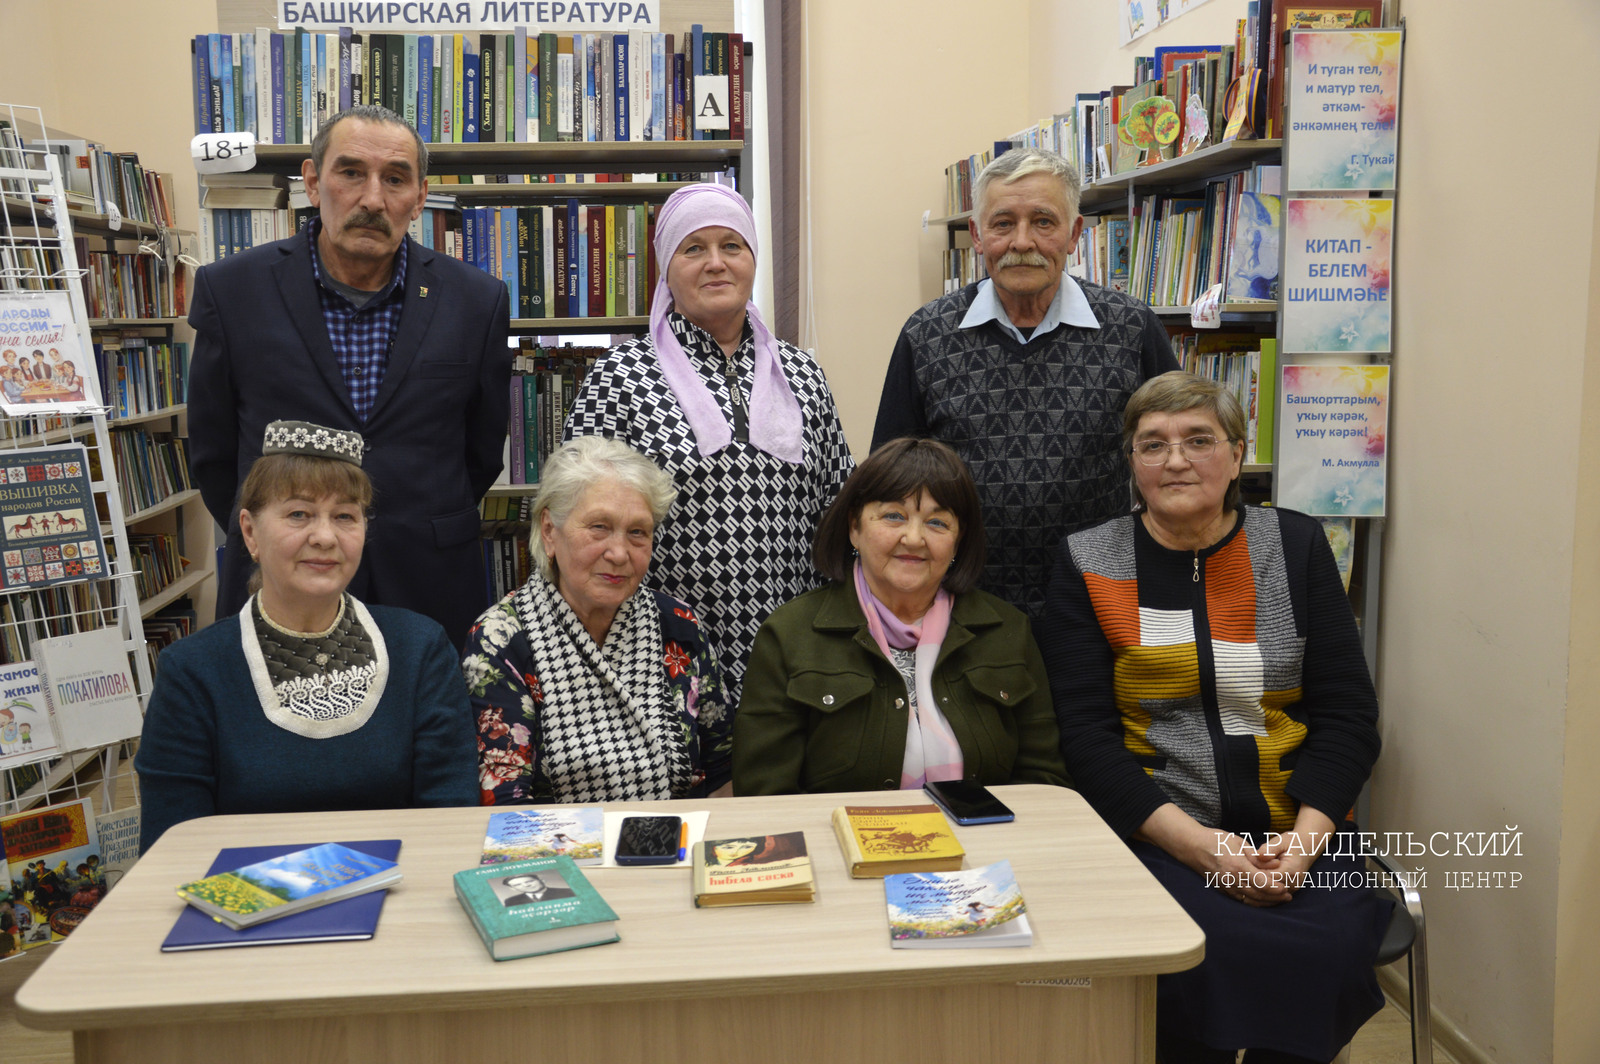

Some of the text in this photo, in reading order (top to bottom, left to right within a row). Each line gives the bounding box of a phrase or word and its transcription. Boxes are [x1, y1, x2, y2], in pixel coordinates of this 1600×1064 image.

[284, 1, 652, 25] БАШКИРСКАЯ ЛИТЕРАТУРА
[1308, 63, 1383, 77] И туган тел,
[733, 74, 741, 116] АБДУЛЛИН
[1305, 84, 1384, 96] и матур тел,
[697, 92, 725, 118] А
[1322, 102, 1366, 112] әткәм-
[1292, 119, 1394, 133] әнкәмнең теле!
[199, 139, 249, 163] 18+
[1350, 153, 1395, 167] Г. Тукай
[1305, 239, 1361, 253] КИТАП
[557, 247, 566, 289] АБДУЛЛИН
[593, 247, 601, 289] АБДУЛЛИН
[1308, 263, 1367, 278] БЕЛЕМ
[0, 308, 50, 320] АРОДЫ
[0, 321, 49, 333] ОССИИ
[1330, 412, 1368, 423] кәрәк,
[1329, 426, 1368, 439] кәрәк!
[1321, 458, 1380, 469] М. Акмулла
[0, 482, 79, 501] ВЫШИВКА
[1, 496, 82, 512] народов России
[57, 671, 131, 706] ПОКАТИЛОВА
[96, 816, 139, 834] Советские
